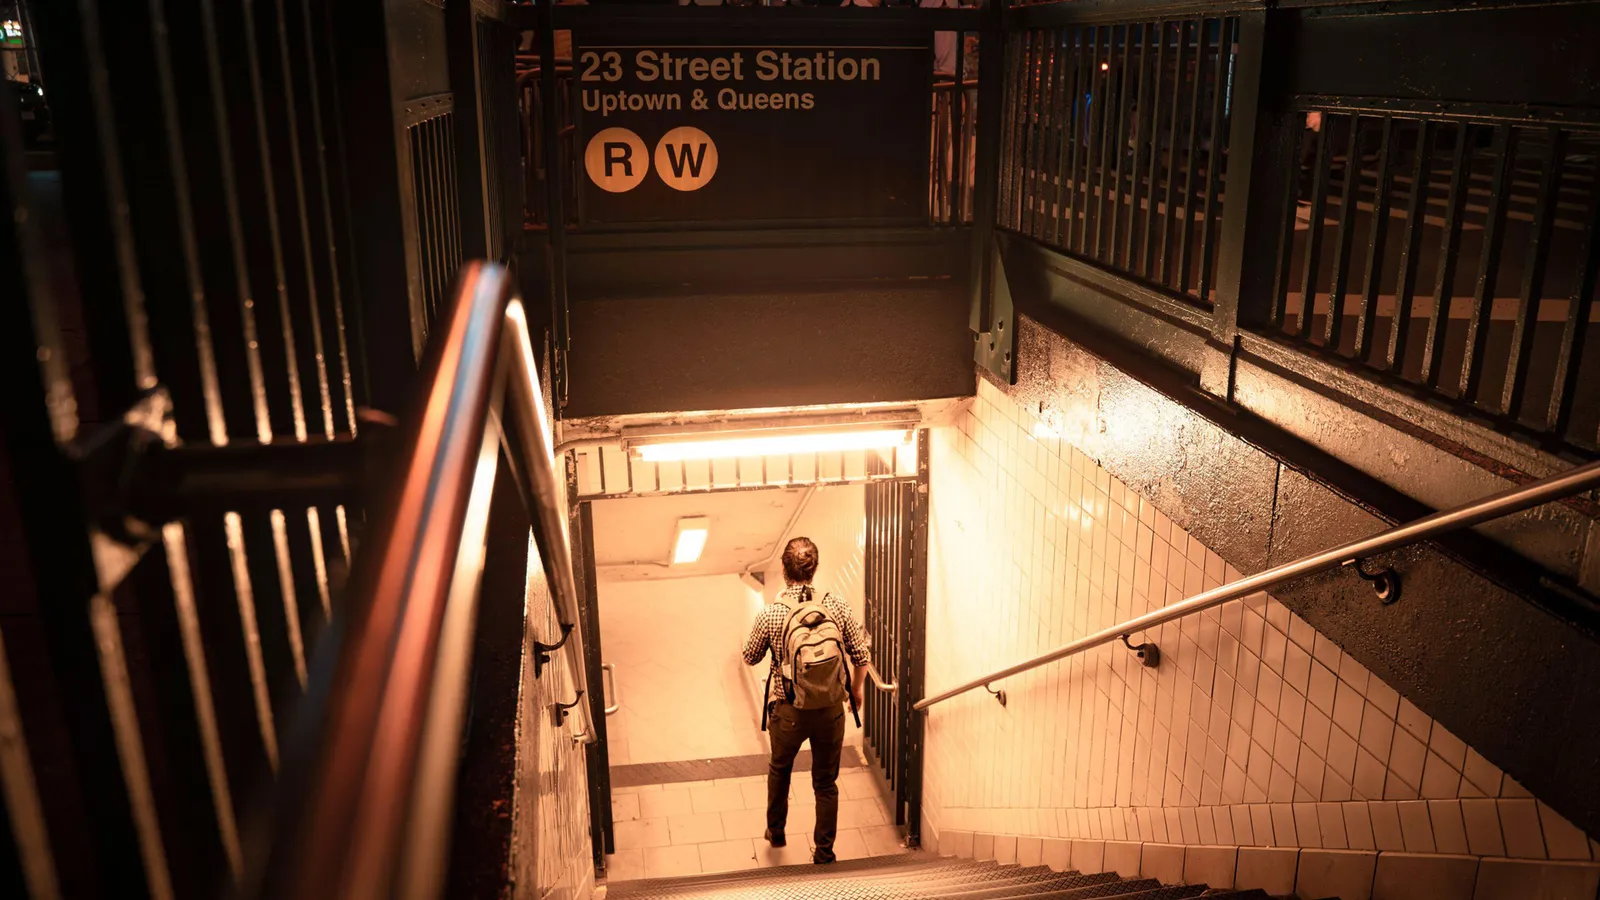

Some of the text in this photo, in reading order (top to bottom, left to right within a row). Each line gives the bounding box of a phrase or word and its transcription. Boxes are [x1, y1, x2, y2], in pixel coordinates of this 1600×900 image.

[580, 50, 881, 82] 23 Street Station
[581, 88, 815, 117] Uptown & Queens
[603, 142, 707, 178] R W
